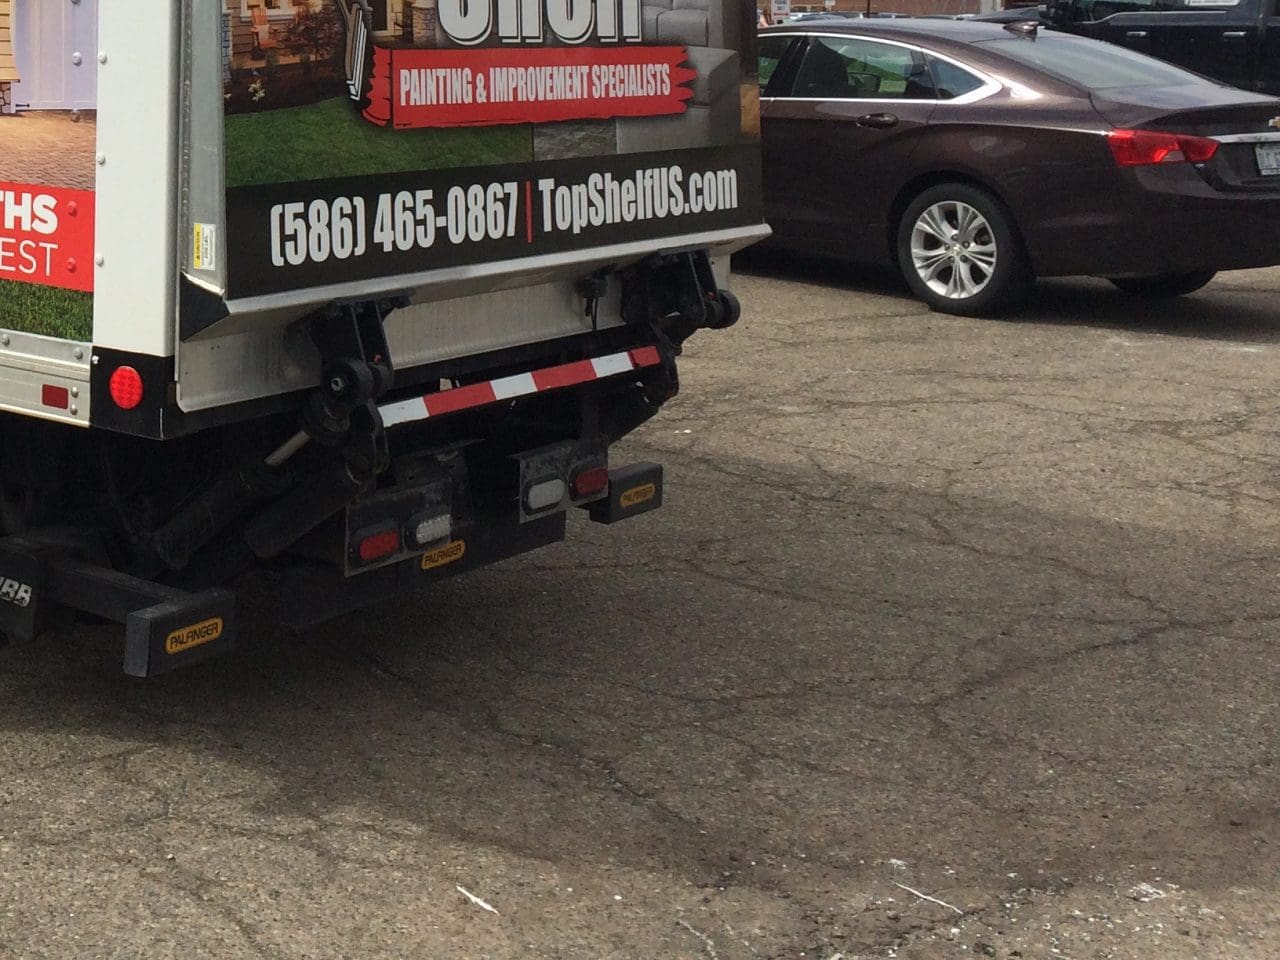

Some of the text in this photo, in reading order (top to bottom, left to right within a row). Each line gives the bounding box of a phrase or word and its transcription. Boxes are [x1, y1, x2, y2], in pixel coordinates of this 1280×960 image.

[400, 63, 671, 106] PAINTING & IMPROVEMENT SPECIALISTS
[270, 196, 366, 267] (586)
[373, 181, 518, 252] 465-0867
[537, 165, 739, 234] TopShelfUS.com
